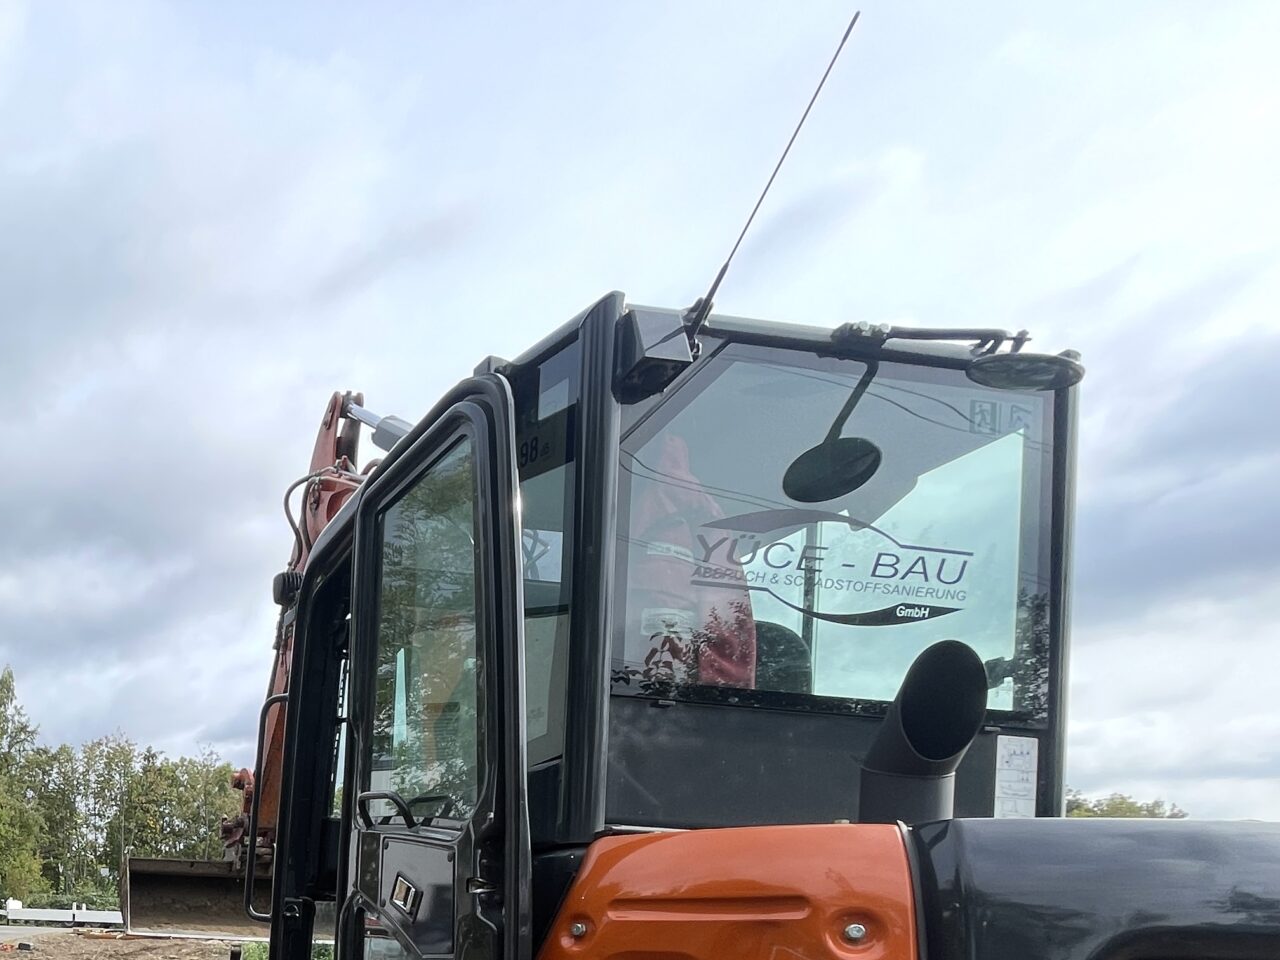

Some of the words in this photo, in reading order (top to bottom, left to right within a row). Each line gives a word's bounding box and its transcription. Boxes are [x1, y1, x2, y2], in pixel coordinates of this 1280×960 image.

[696, 533, 829, 573] YÜCE
[870, 552, 968, 585] BAU
[770, 573, 779, 586] &
[783, 574, 967, 601] SCADSTOFFSANIERUNG
[895, 605, 930, 619] GmbH
